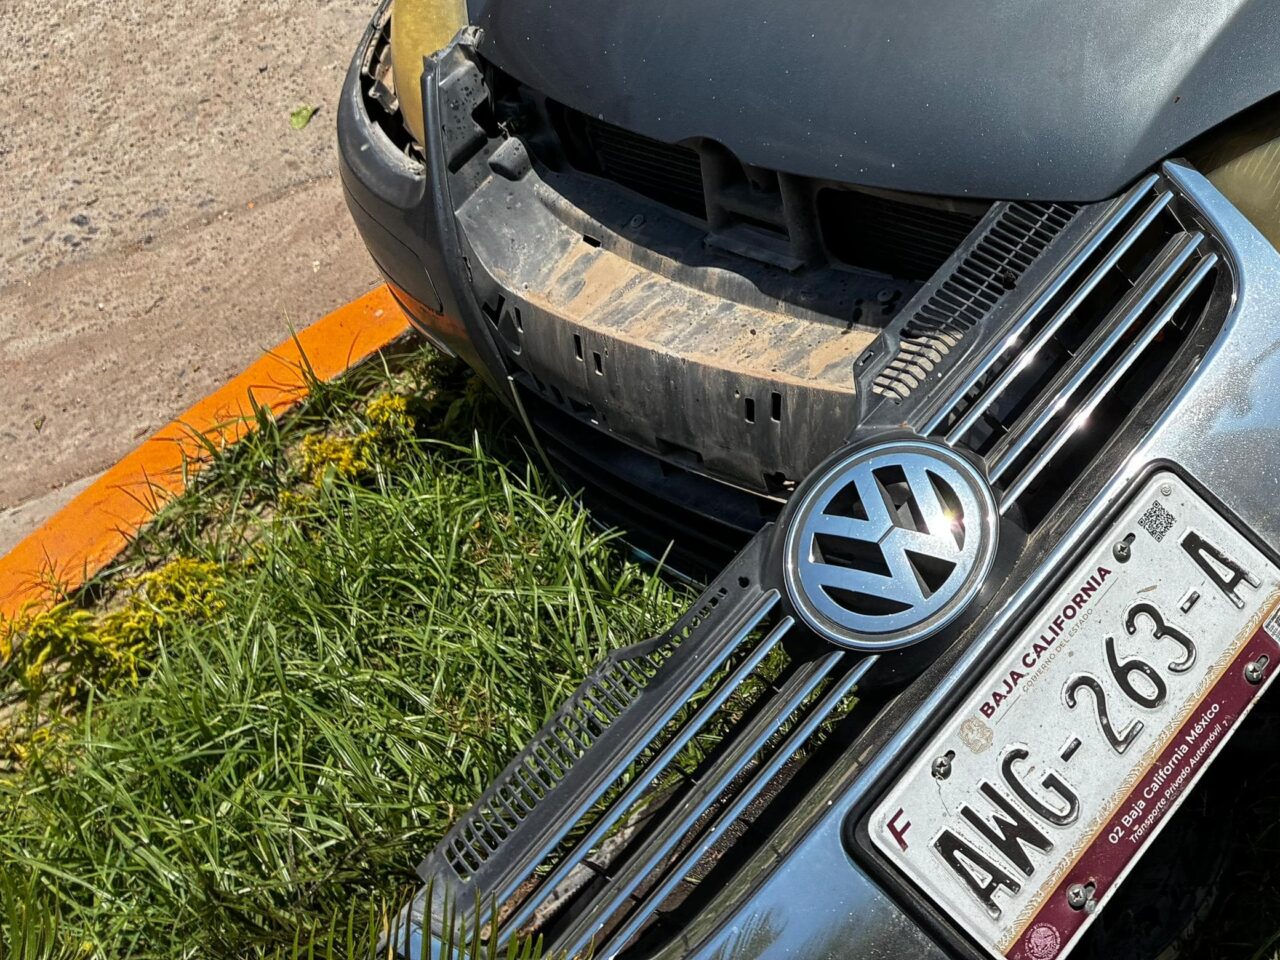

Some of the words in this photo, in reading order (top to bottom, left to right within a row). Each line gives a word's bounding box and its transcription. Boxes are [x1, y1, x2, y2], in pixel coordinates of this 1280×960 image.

[979, 670, 1025, 719] BAJA
[1022, 566, 1112, 668] CALIFORNIA
[1022, 653, 1056, 693] GOBIERNO
[1056, 637, 1070, 653] DEL
[1069, 608, 1093, 637] ESTADO
[933, 530, 1262, 921] AWG-263-A
[1108, 826, 1125, 844] 02
[1121, 801, 1146, 828] Baja
[1143, 746, 1189, 799] California
[1185, 703, 1220, 744] México
[1129, 798, 1167, 843] Transporte
[1164, 767, 1191, 798] Privado
[1190, 725, 1223, 768] Automóvil
[886, 807, 912, 853] F
